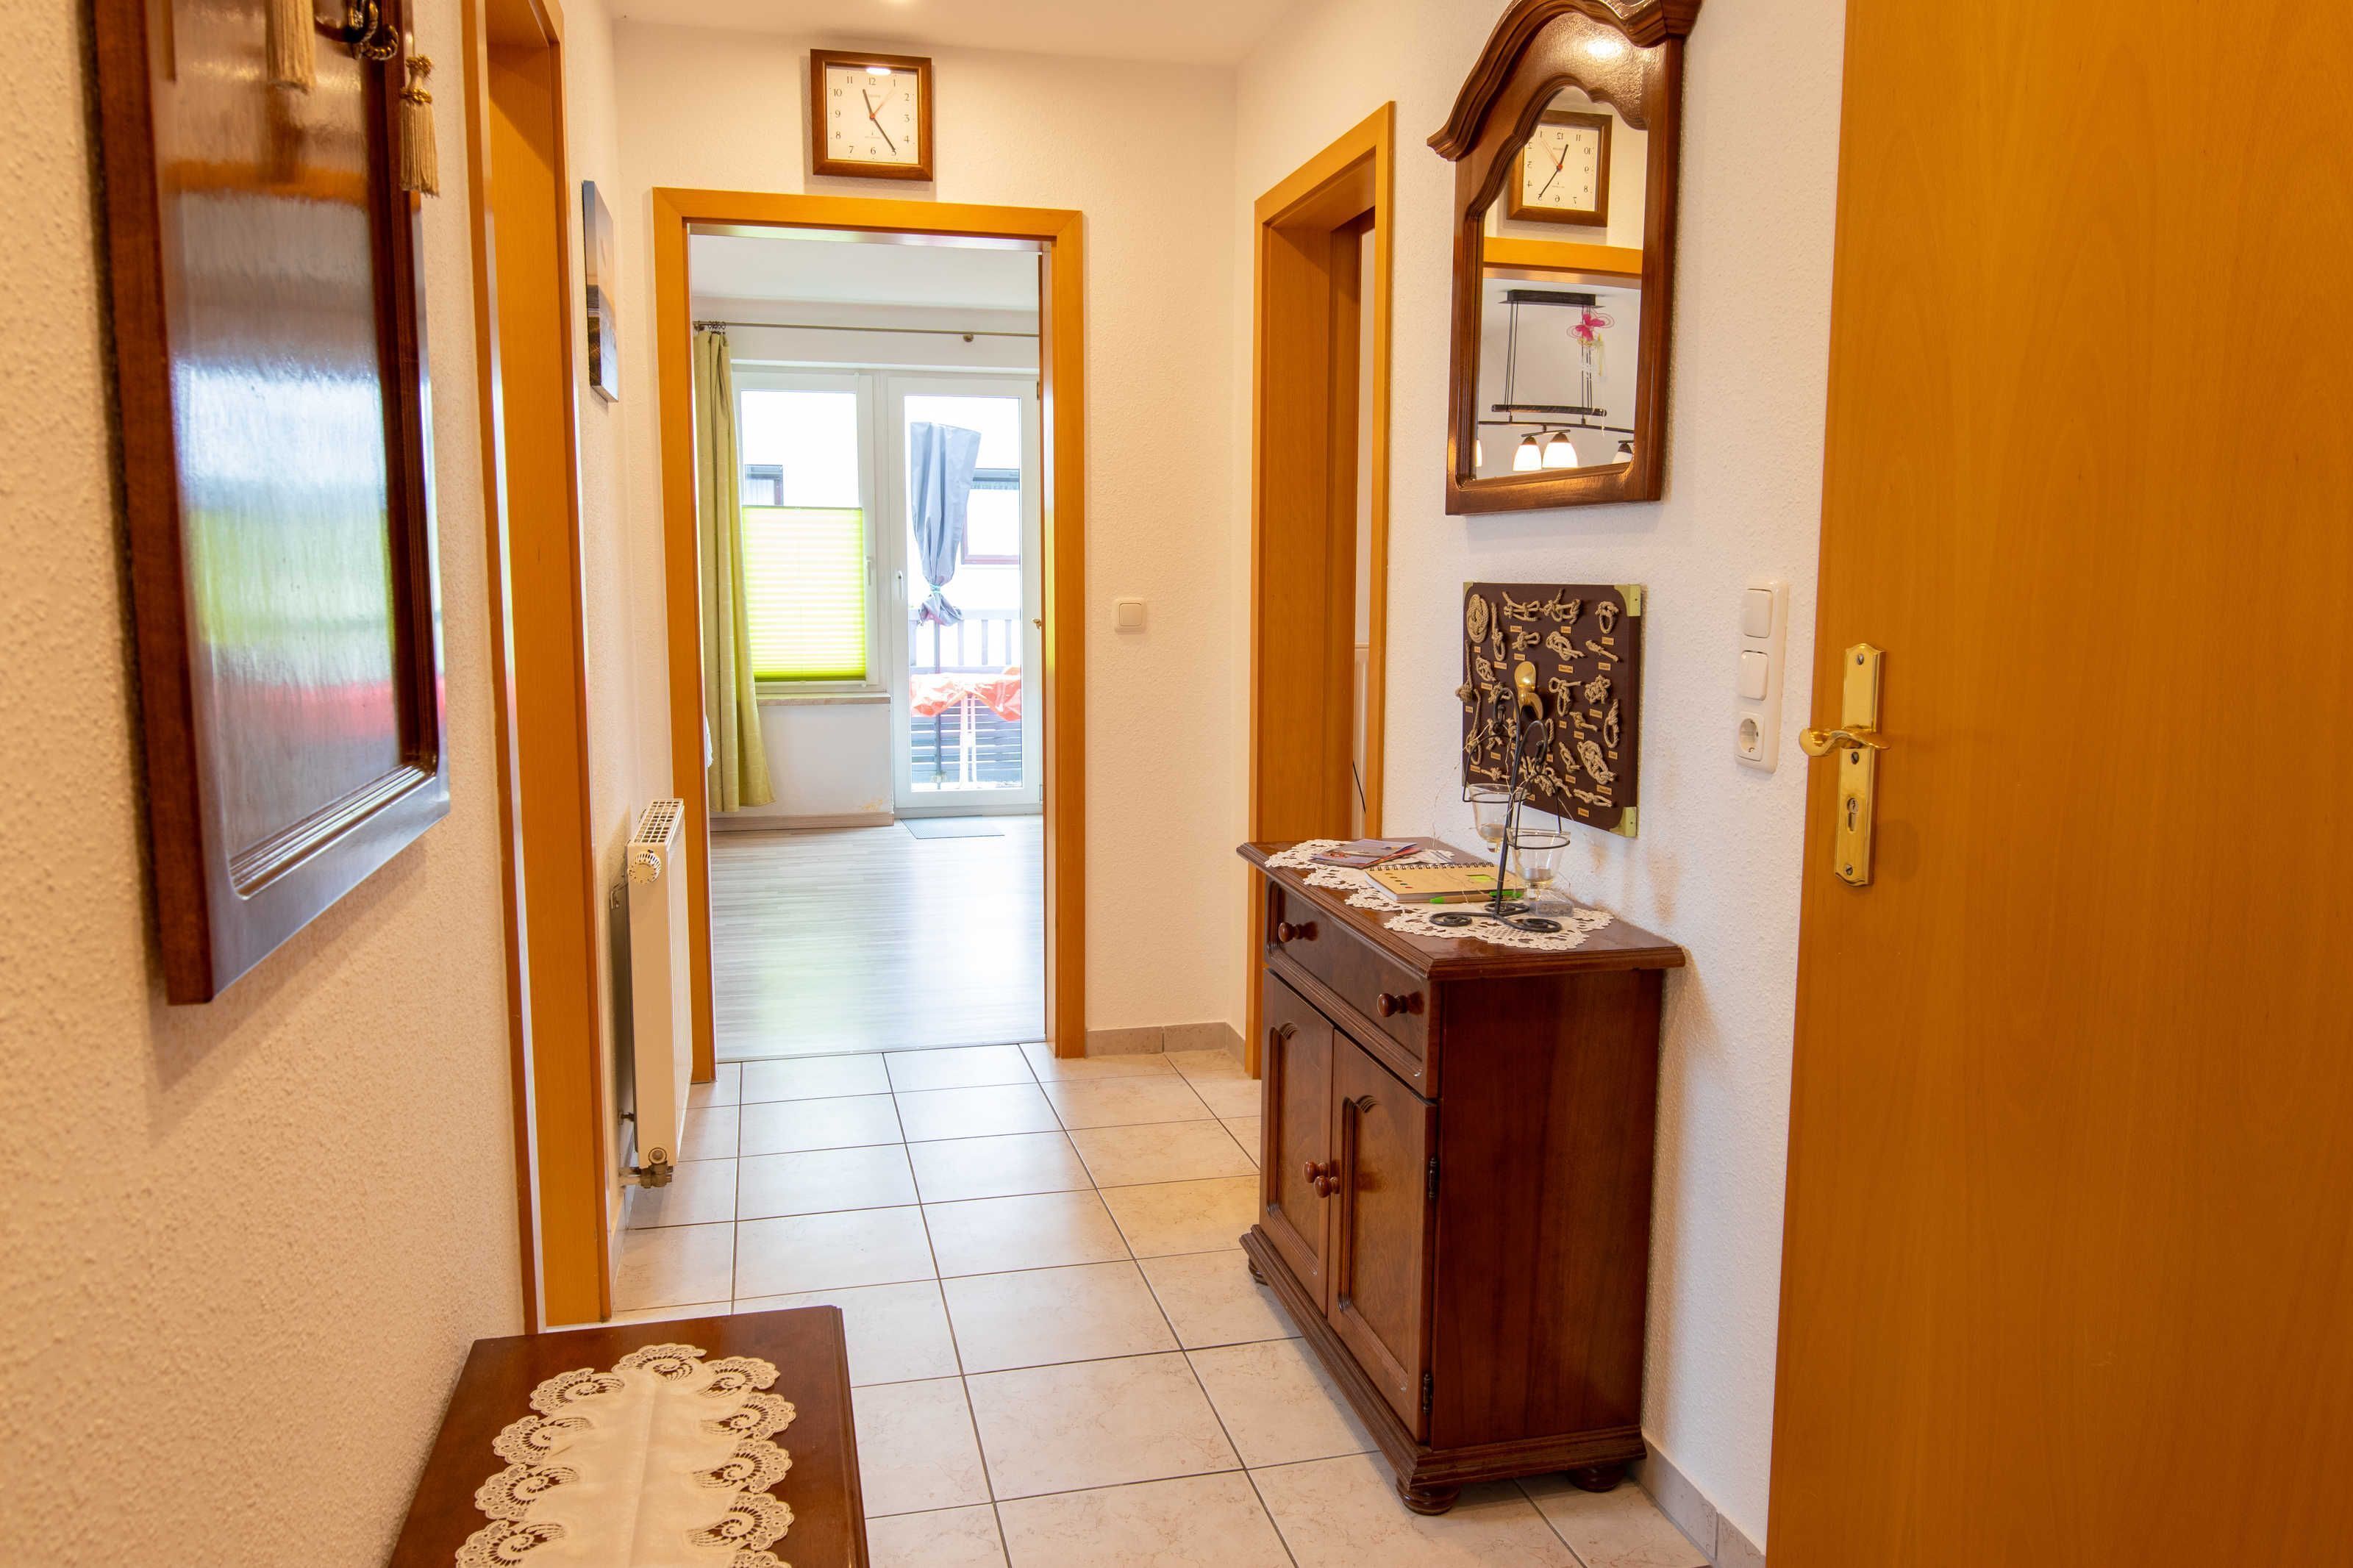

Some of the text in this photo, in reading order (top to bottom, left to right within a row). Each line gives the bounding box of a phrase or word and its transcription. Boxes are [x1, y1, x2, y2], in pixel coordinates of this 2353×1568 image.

[868, 77, 876, 85] 12
[904, 93, 910, 101] 2
[835, 110, 841, 118] 9
[904, 114, 910, 122] 3
[836, 131, 841, 139] 8
[904, 135, 910, 143] 4
[870, 146, 876, 155] 6
